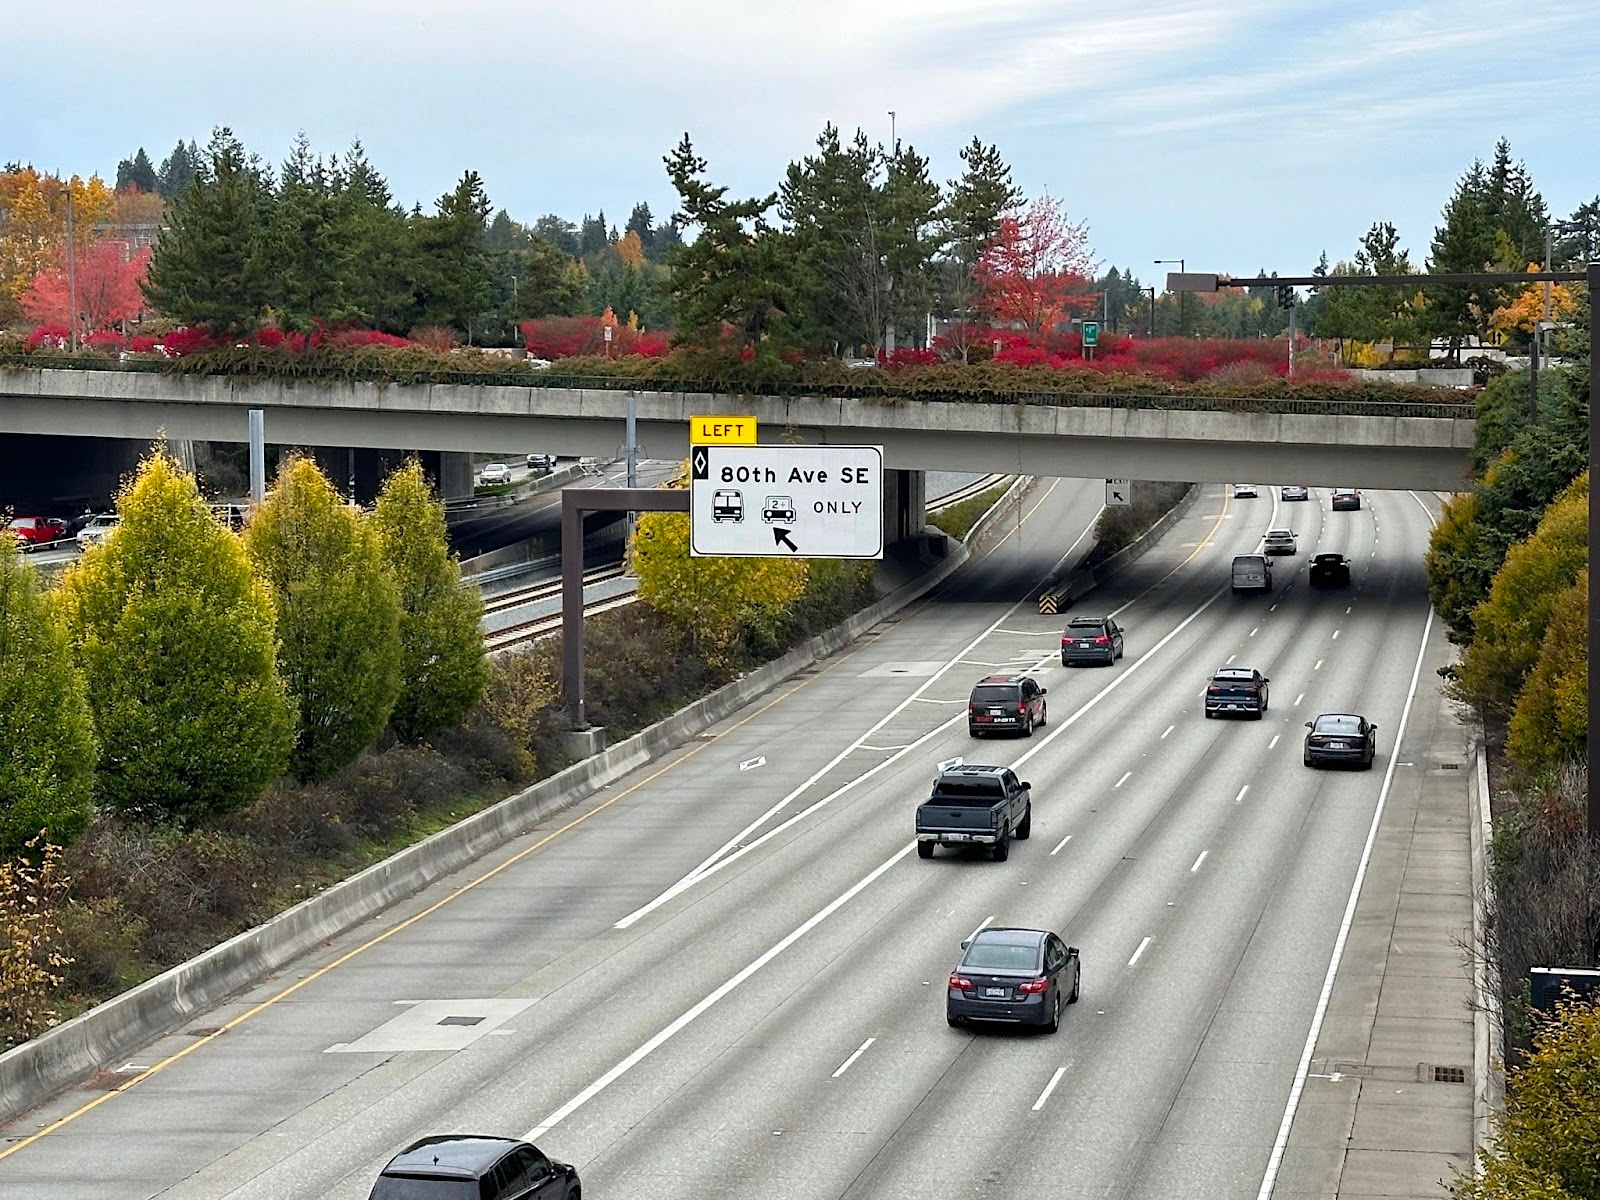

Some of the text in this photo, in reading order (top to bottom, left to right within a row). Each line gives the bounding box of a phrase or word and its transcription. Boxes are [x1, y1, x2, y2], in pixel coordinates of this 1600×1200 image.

[703, 424, 744, 437] LEFT
[721, 466, 869, 484] 80th Ave SE
[813, 501, 862, 514] ONLY
